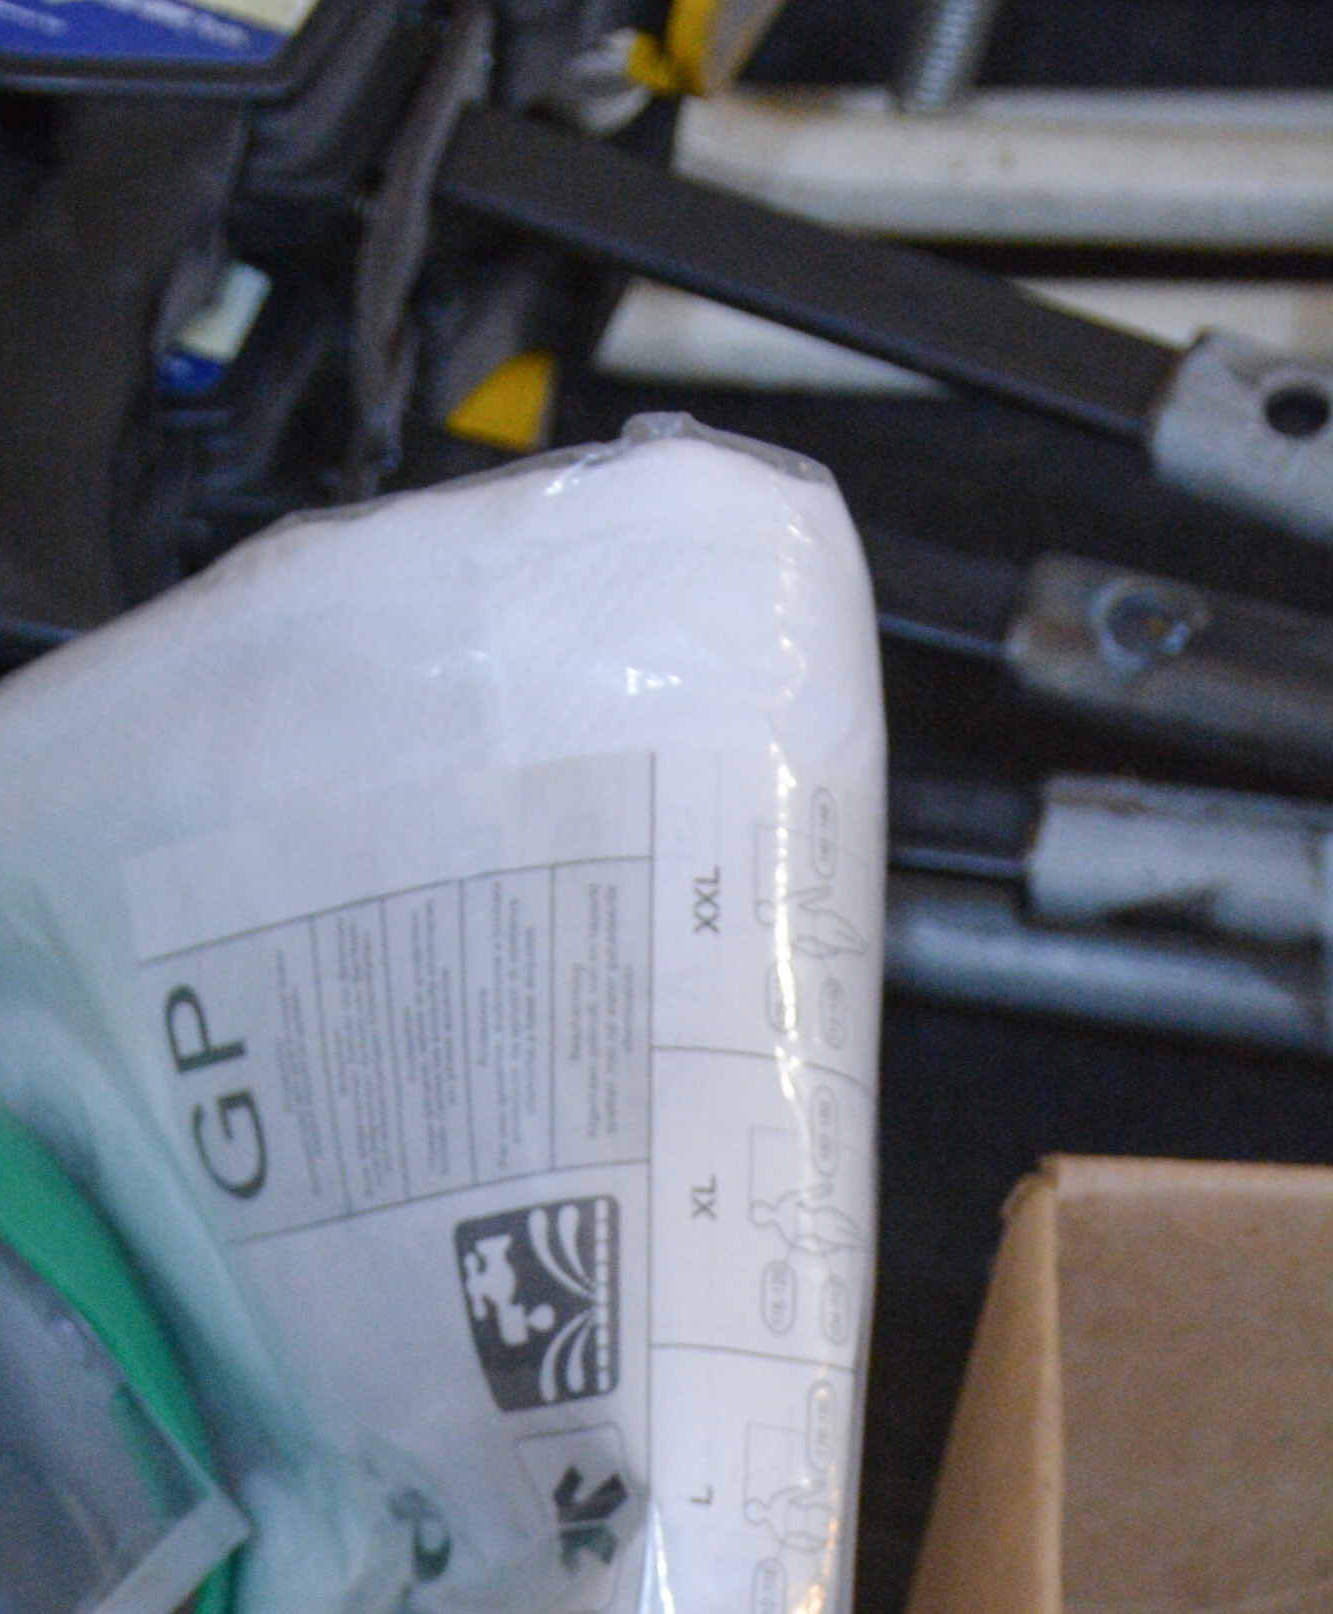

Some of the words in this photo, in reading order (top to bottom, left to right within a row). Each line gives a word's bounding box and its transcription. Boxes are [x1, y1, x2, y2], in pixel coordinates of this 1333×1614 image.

[691, 864, 722, 935] XXL
[163, 983, 268, 1201] GP
[691, 1174, 718, 1221] XL
[690, 1484, 713, 1506] L
